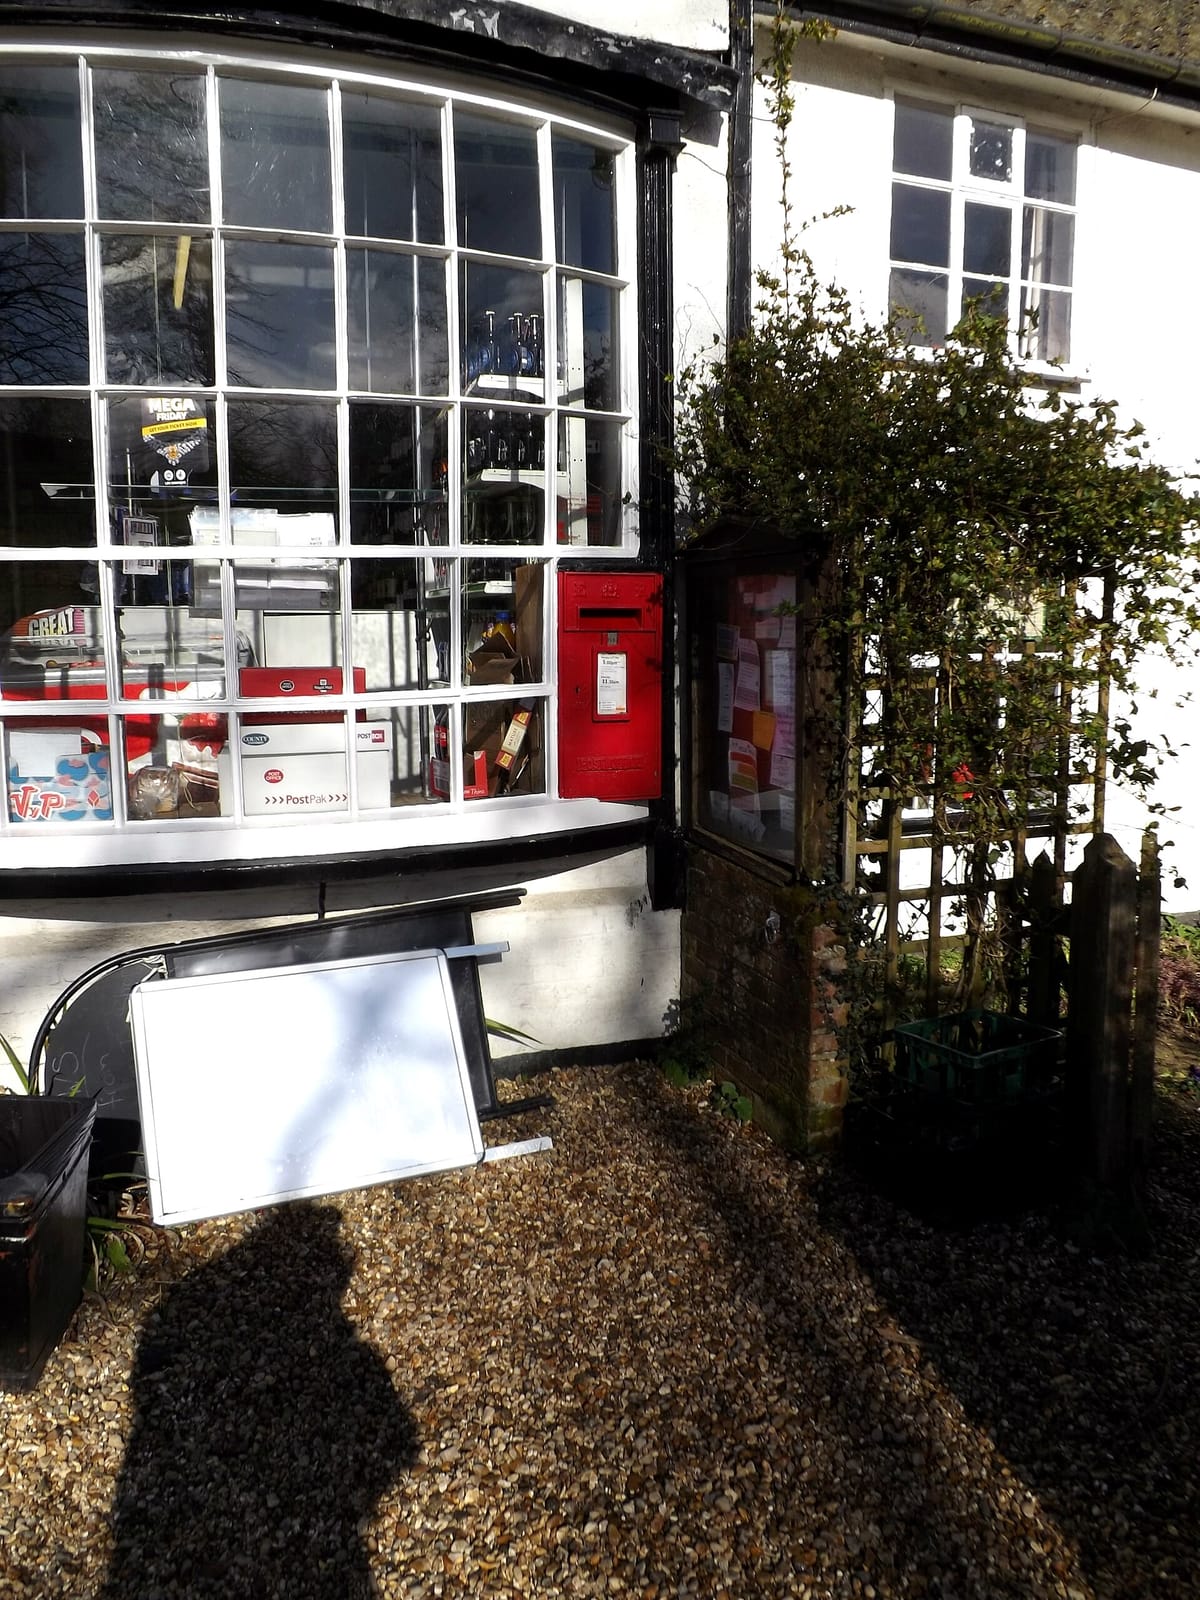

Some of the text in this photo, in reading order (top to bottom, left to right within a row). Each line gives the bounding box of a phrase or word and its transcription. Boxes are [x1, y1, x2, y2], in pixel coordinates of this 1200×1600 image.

[147, 398, 196, 413] MEGA
[156, 412, 188, 421] FRIDAY
[28, 608, 75, 637] GREAT
[243, 734, 268, 742] COUNTY
[286, 793, 327, 805] PostPak
